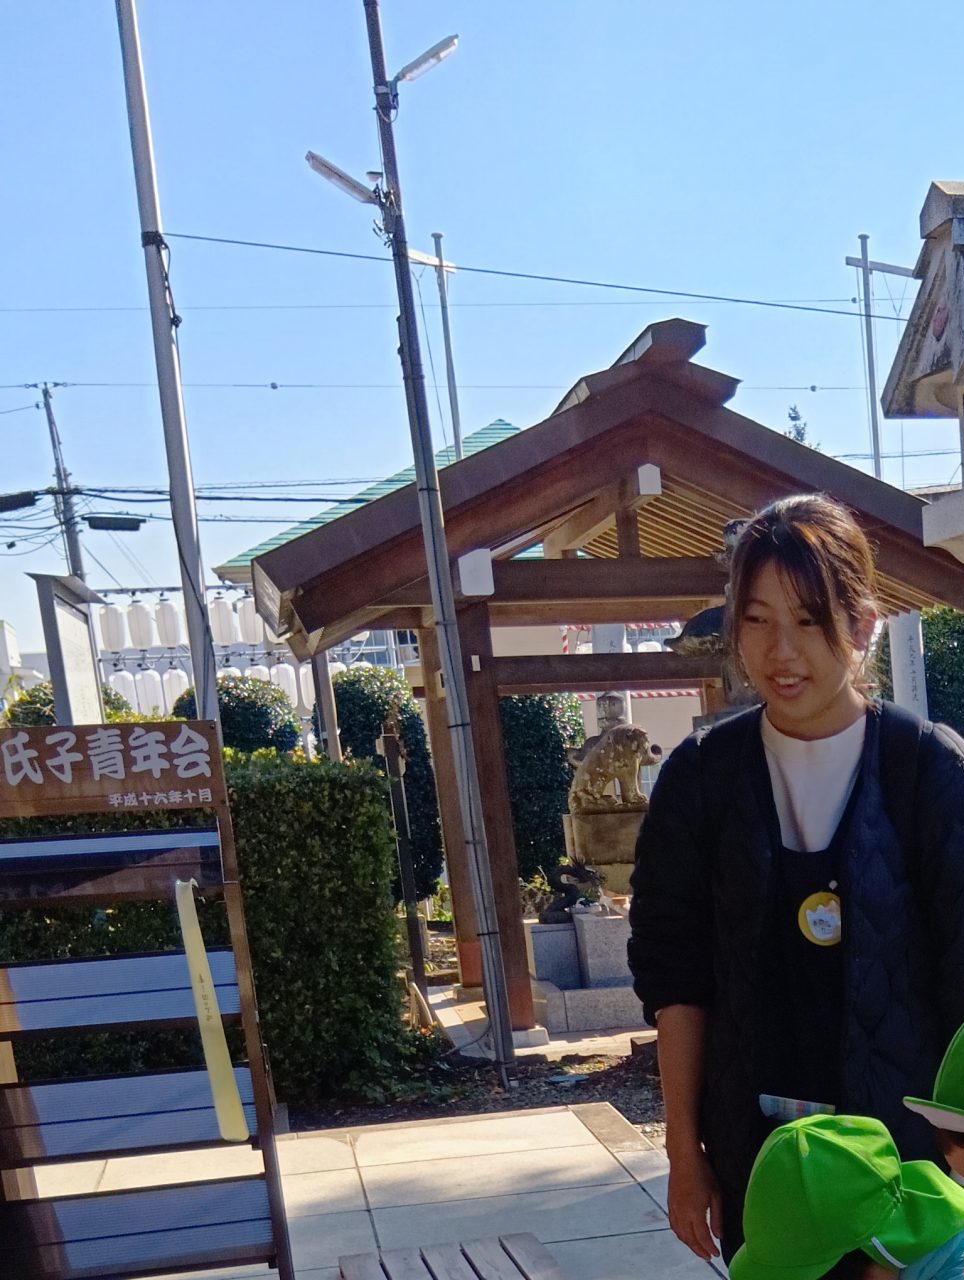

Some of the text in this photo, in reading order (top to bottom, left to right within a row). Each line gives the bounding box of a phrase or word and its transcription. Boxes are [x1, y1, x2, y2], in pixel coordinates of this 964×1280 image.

[2, 723, 212, 787] 氏子青年会
[109, 788, 213, 807] 平成十六年十月
